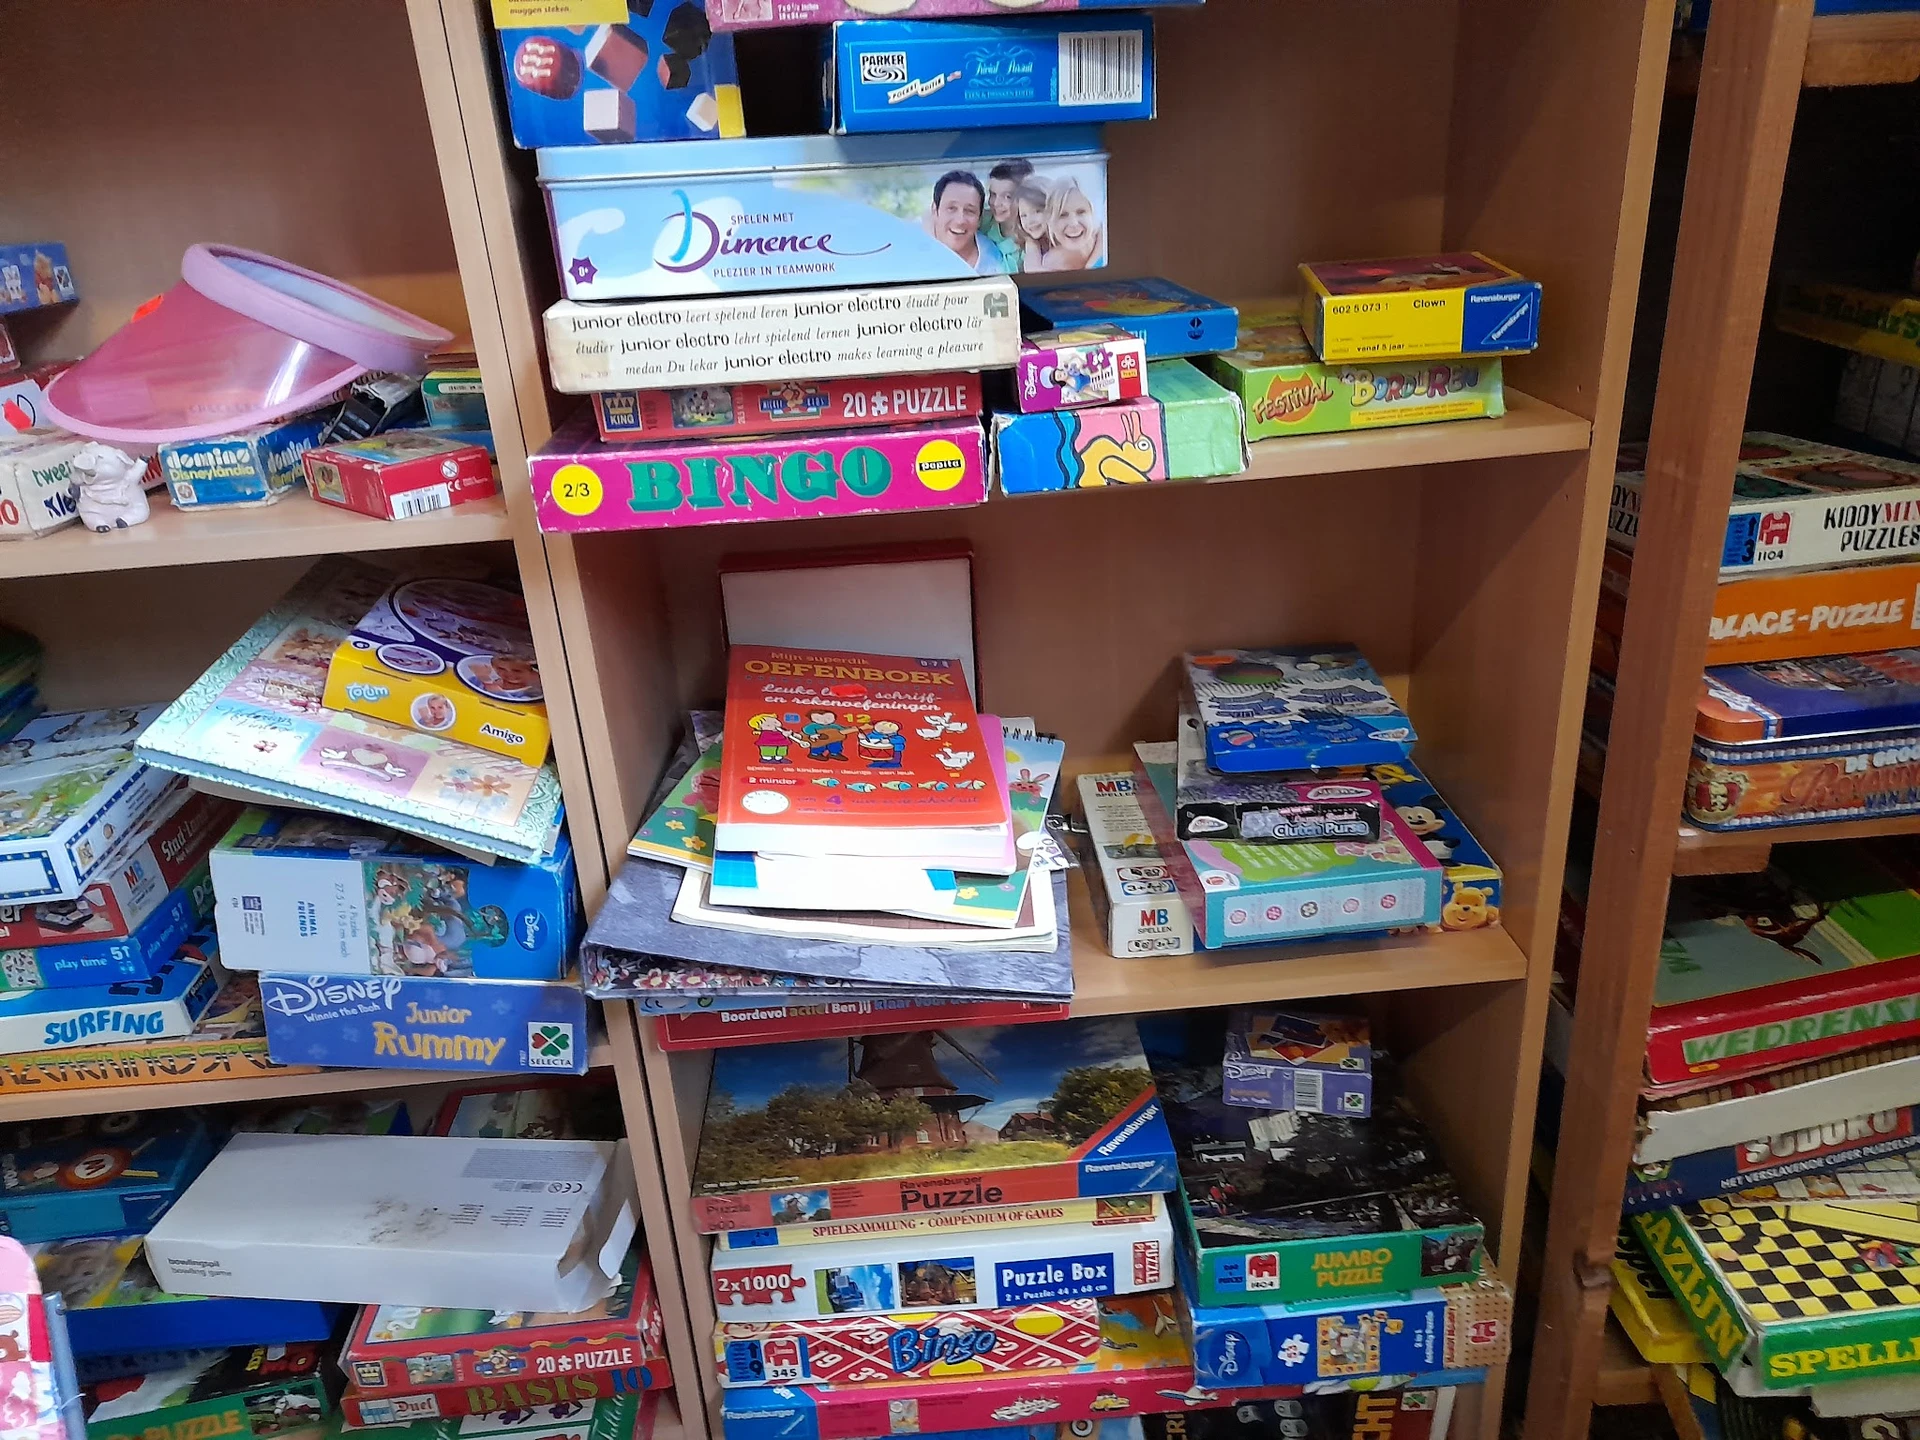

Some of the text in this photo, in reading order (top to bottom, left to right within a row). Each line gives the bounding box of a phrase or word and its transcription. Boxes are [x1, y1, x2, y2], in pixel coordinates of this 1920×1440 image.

[862, 54, 905, 67] PARKER
[730, 212, 795, 226] SPELEN MET
[653, 189, 845, 273] Dimence
[713, 262, 836, 279] PLEZIER IN TEAMWORK
[1332, 303, 1351, 315] 602
[1361, 302, 1381, 313] 073
[1413, 298, 1446, 309] Clown
[1470, 293, 1521, 304] Ravensburger
[572, 315, 622, 333] junior
[627, 311, 682, 328] electro
[686, 309, 711, 324] leert
[714, 306, 756, 323] spelend
[761, 304, 789, 319] leren
[794, 301, 844, 319] junior
[847, 295, 901, 313] electro
[943, 294, 970, 311] pour
[1491, 302, 1529, 341] Ravensburger
[620, 337, 671, 355] junior
[676, 331, 730, 350] electro
[734, 332, 761, 347] lehrt
[765, 327, 811, 346] spielend
[816, 326, 850, 340] lernen
[856, 321, 906, 340] junior
[910, 316, 963, 333] electro
[1356, 343, 1380, 352] vanaf
[1388, 342, 1405, 352] jaar
[625, 360, 662, 376] medan
[667, 359, 685, 374] Du
[689, 359, 719, 373] lekar
[724, 355, 774, 372] junior
[778, 348, 832, 367] electro
[837, 347, 872, 362] makes
[876, 343, 923, 361] learning
[927, 346, 934, 356] a
[938, 341, 984, 358] pleasure
[1025, 362, 1039, 400] Disney
[843, 385, 967, 418] 20 PUZZLE
[610, 414, 635, 426] KING
[563, 481, 591, 499] 2/3
[624, 445, 893, 514] BINGO
[1757, 549, 1784, 562] 1104
[770, 651, 802, 662] Mijn
[744, 660, 955, 685] OEFENBOEK
[765, 695, 941, 713] en rekenoefeningen
[480, 723, 525, 744] Amigo
[759, 777, 798, 785] minder
[1096, 780, 1133, 792] MB
[1273, 820, 1370, 839] Clutch Purse
[124, 860, 145, 889] MB
[298, 900, 308, 938] FRIENDS
[307, 902, 318, 937] ANIMAL
[1140, 908, 1170, 927] MB
[523, 909, 540, 951] Disney
[1137, 925, 1173, 934] SPELLEN
[54, 956, 108, 972] play time
[304, 1002, 381, 1024] Winnie the Pooh
[405, 1002, 473, 1025] Junior
[720, 1007, 788, 1023] Boordevol
[831, 1002, 857, 1014] Ben
[43, 1010, 165, 1045] SURFING
[372, 1021, 506, 1066] Rummy
[529, 1057, 572, 1067] SELECTA
[1096, 1103, 1160, 1157] Ravensburger
[1084, 1160, 1156, 1173] Ravensburger
[1720, 1176, 1744, 1190] HET
[1744, 1159, 1825, 1185] VERSLAVENDE
[900, 1175, 983, 1190] Ravensburger
[901, 1185, 1003, 1213] Puzzle
[813, 1208, 1065, 1238] SPIELESAMMLUNG COMPENDIUM OF GAMES
[1145, 1240, 1160, 1284] PUZZLE
[1311, 1247, 1393, 1271] JUMBO
[170, 1267, 207, 1278] bowling
[717, 1273, 791, 1293] 2x1000
[1002, 1263, 1108, 1288] Puzzle Box
[1316, 1267, 1384, 1288] PUZZLE
[1005, 1293, 1012, 1302] 2
[1023, 1289, 1056, 1300] Puzzle:
[1056, 1287, 1070, 1296] 44
[1095, 1284, 1108, 1292] cm
[848, 1324, 890, 1346] 29
[1066, 1330, 1101, 1348] 71
[808, 1350, 844, 1369] 19
[887, 1325, 998, 1374] Bingo
[1218, 1334, 1240, 1376] Disney
[536, 1347, 633, 1375] 20 PUZZLE
[772, 1368, 798, 1378] 345
[466, 1366, 653, 1414] BASIS 10
[395, 1397, 433, 1412] Duel
